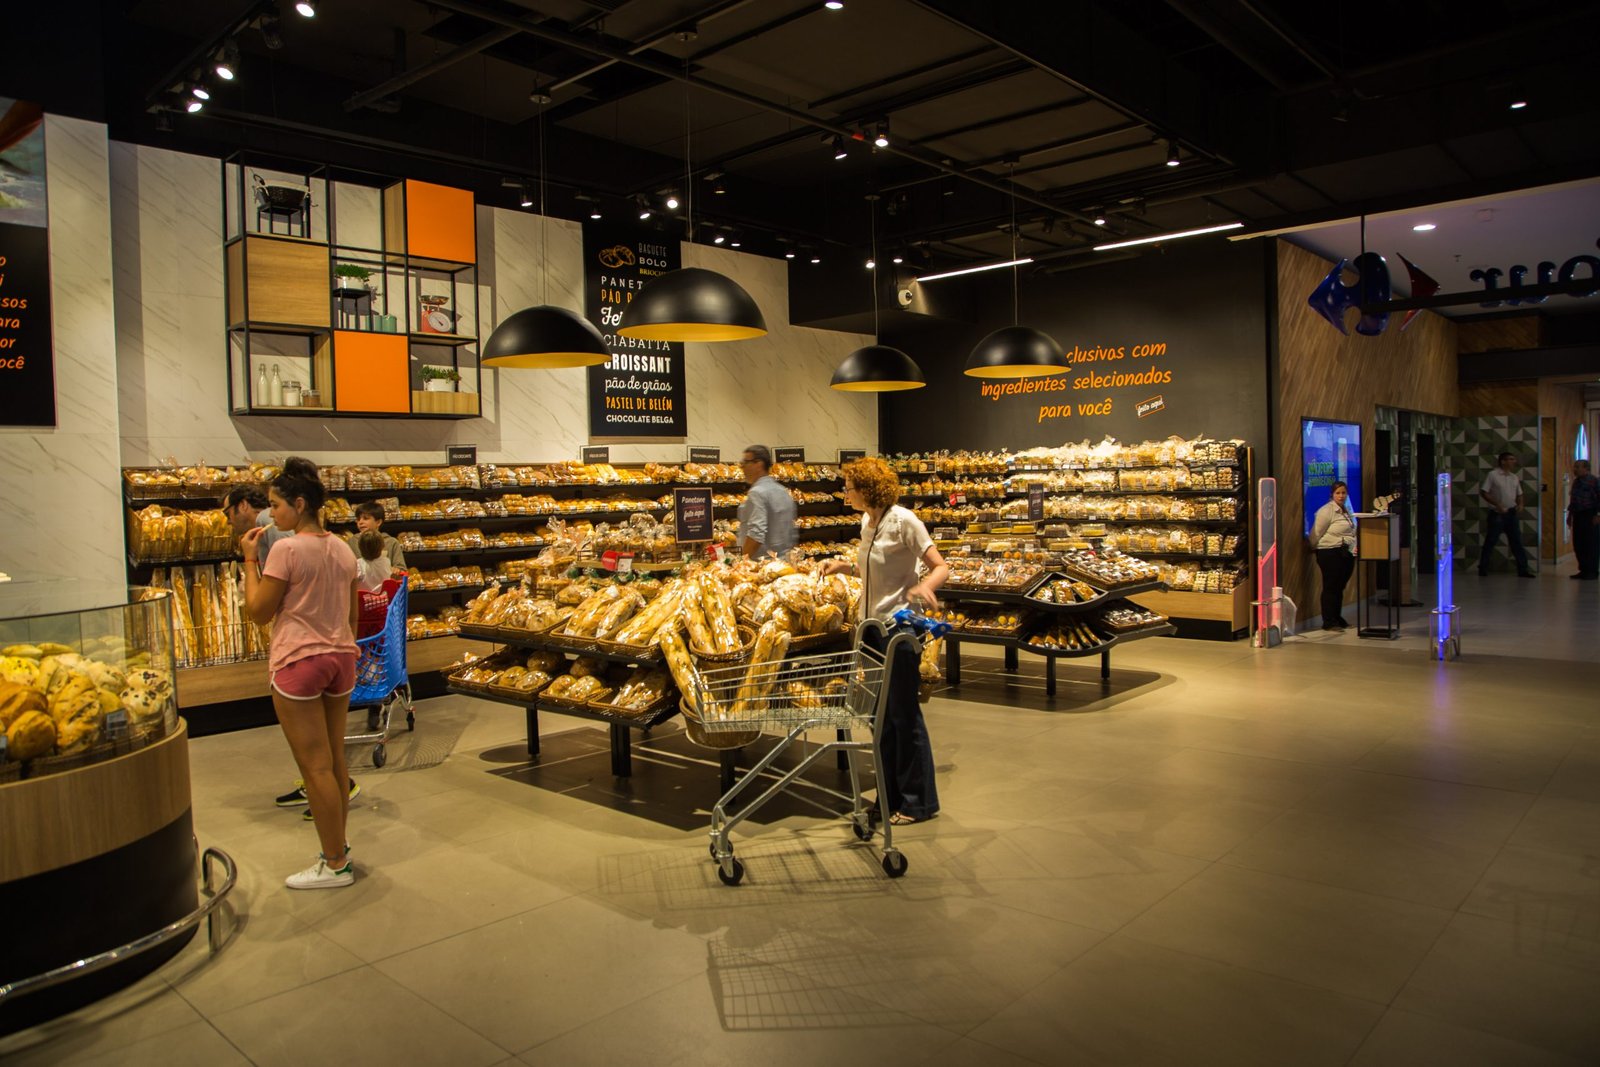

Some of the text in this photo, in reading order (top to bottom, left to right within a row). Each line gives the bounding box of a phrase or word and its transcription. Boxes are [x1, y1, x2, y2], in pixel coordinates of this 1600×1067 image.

[638, 242, 667, 257] BAGUETE
[639, 256, 667, 268] BOLO
[601, 275, 643, 290] PANET
[600, 306, 623, 326] Fei
[603, 334, 671, 351] CIABATTA
[1065, 343, 1167, 364] clusivas com
[604, 375, 673, 395] pão de grãos
[981, 366, 1172, 401] ingredientes selecionados
[606, 396, 673, 411] PASTEL DE BELÉM
[1038, 398, 1112, 423] para você
[606, 414, 674, 424] CHOCOLATE BELGA
